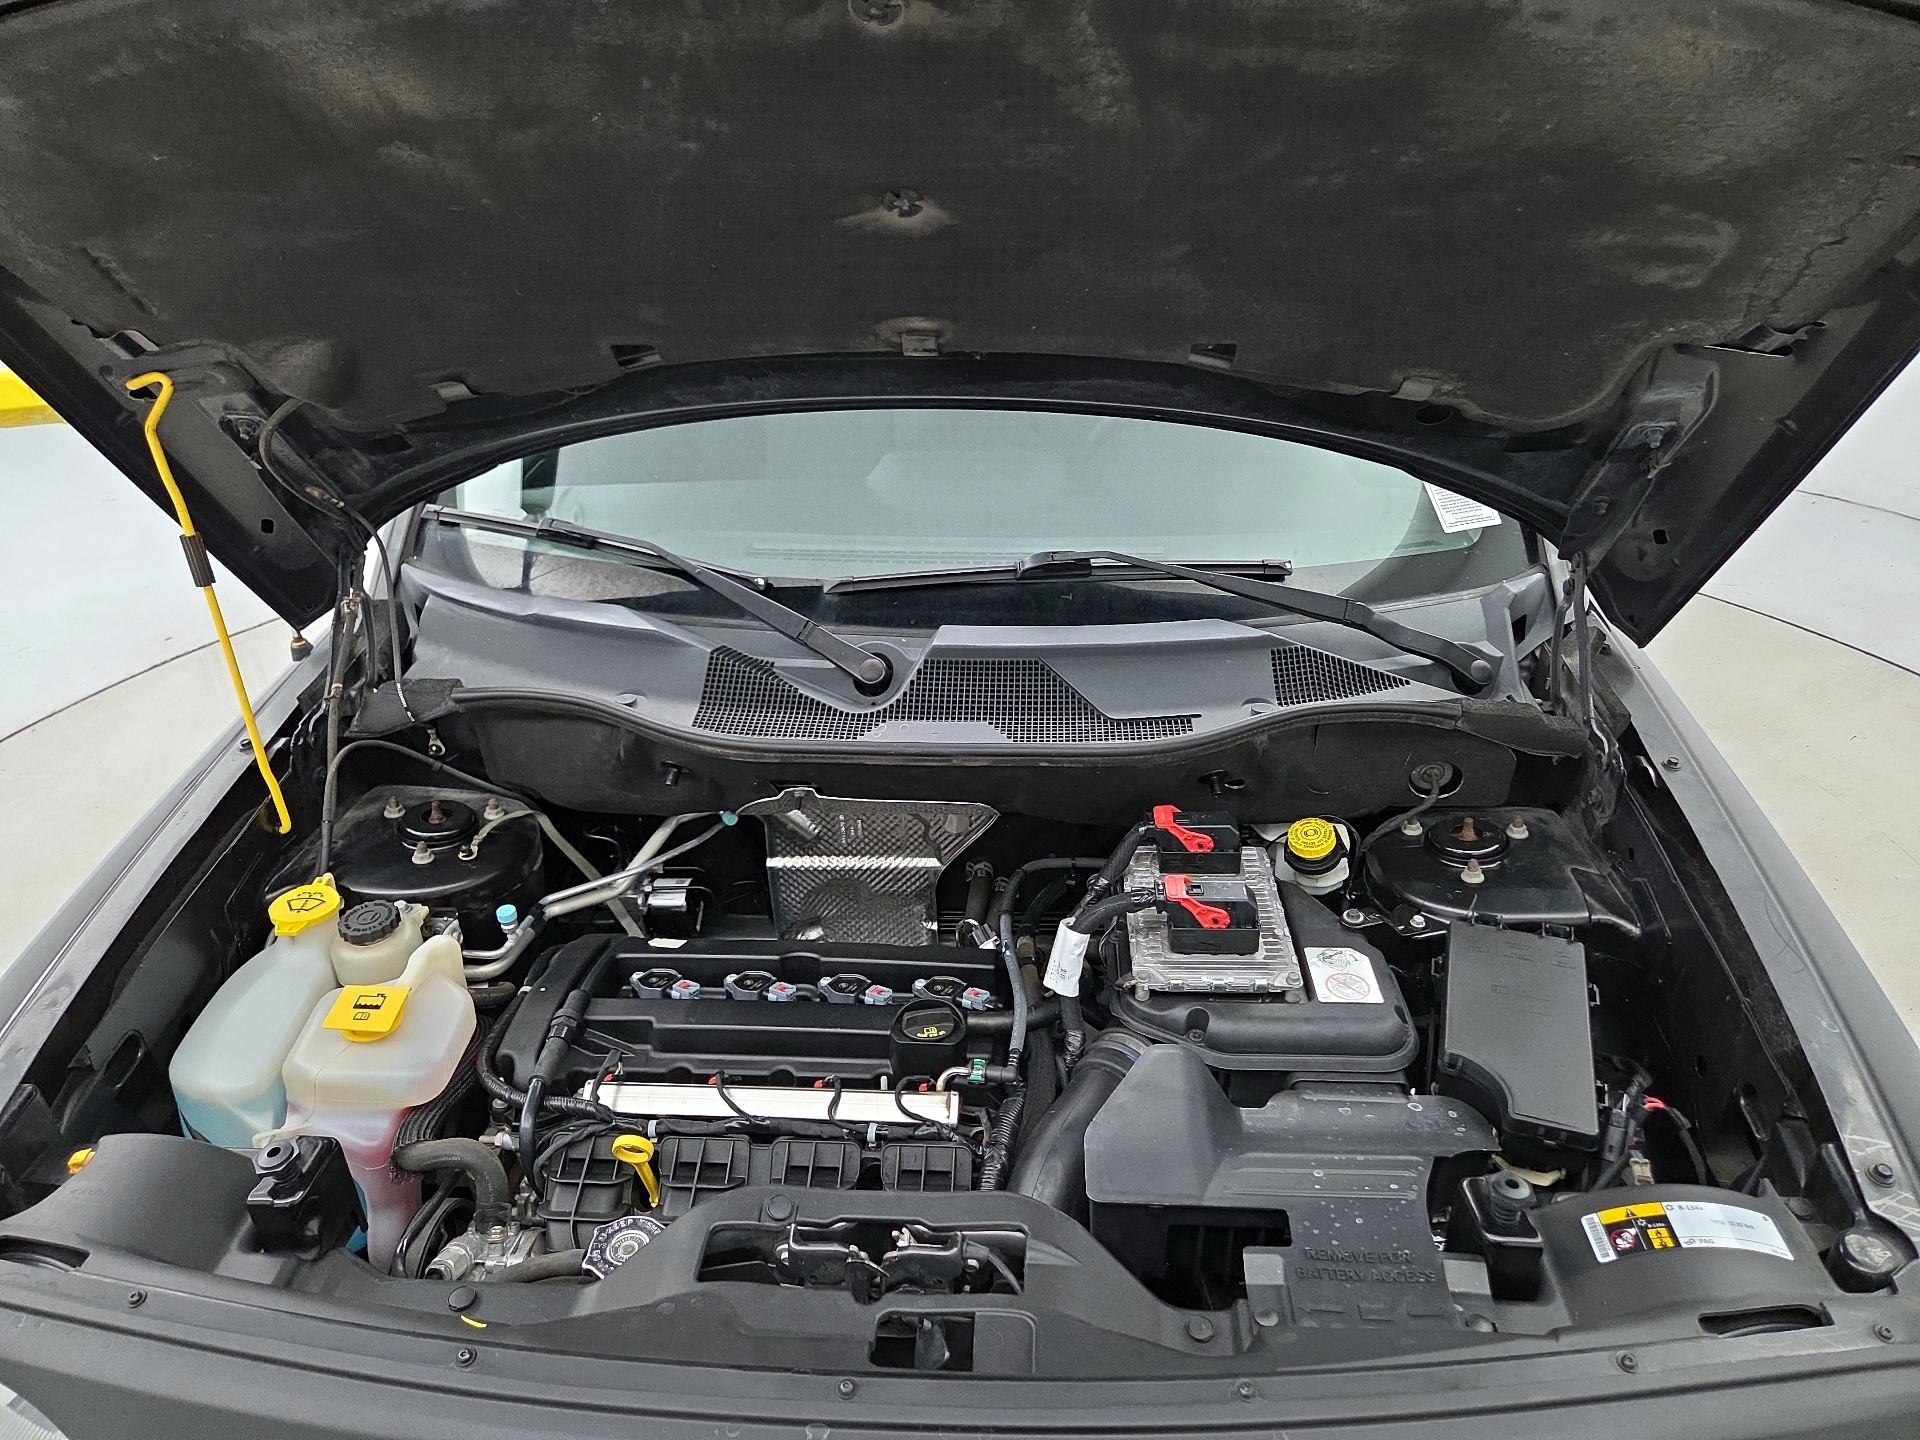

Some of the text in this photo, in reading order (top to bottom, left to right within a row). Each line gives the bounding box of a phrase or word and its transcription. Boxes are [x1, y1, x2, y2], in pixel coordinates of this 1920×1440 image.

[1304, 1247, 1414, 1264] REMOVE FOR
[1296, 1267, 1438, 1284] BATTERY ACCESS
